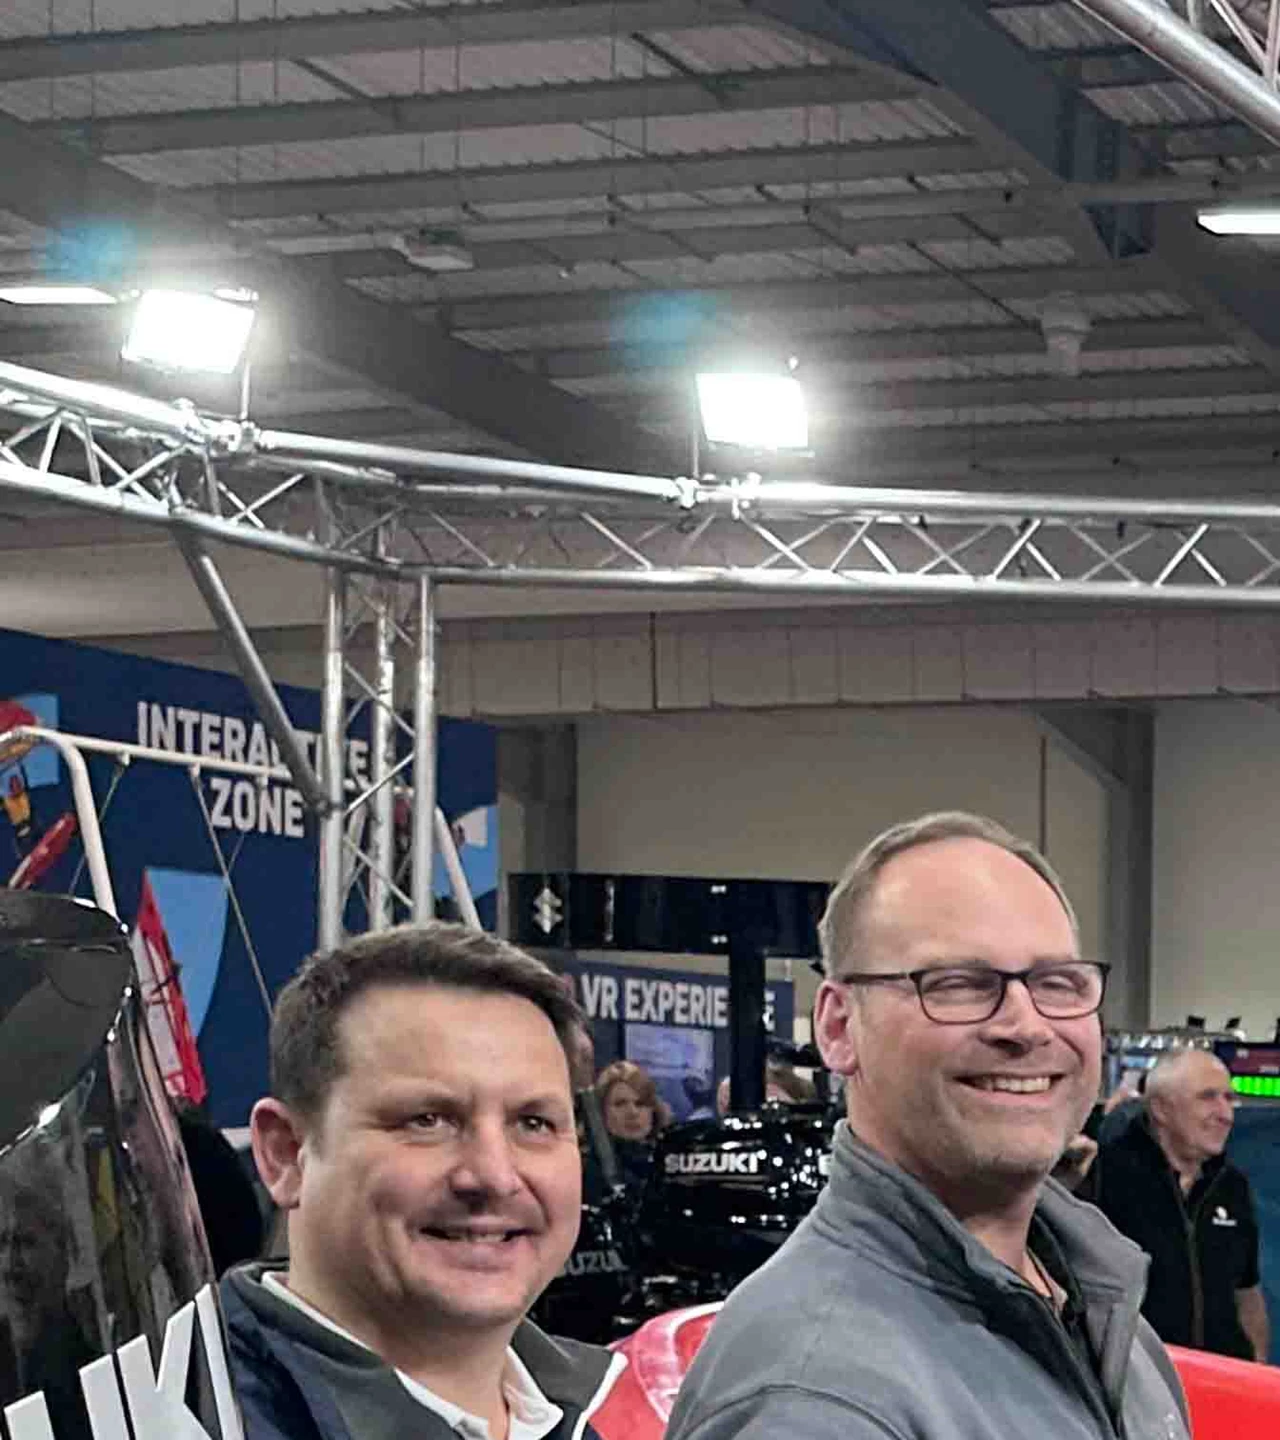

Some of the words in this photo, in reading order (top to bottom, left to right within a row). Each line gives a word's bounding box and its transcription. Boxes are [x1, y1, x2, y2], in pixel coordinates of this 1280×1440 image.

[209, 777, 304, 838] ZONE
[581, 974, 618, 1019] VR
[664, 1151, 768, 1174] SUZUKI
